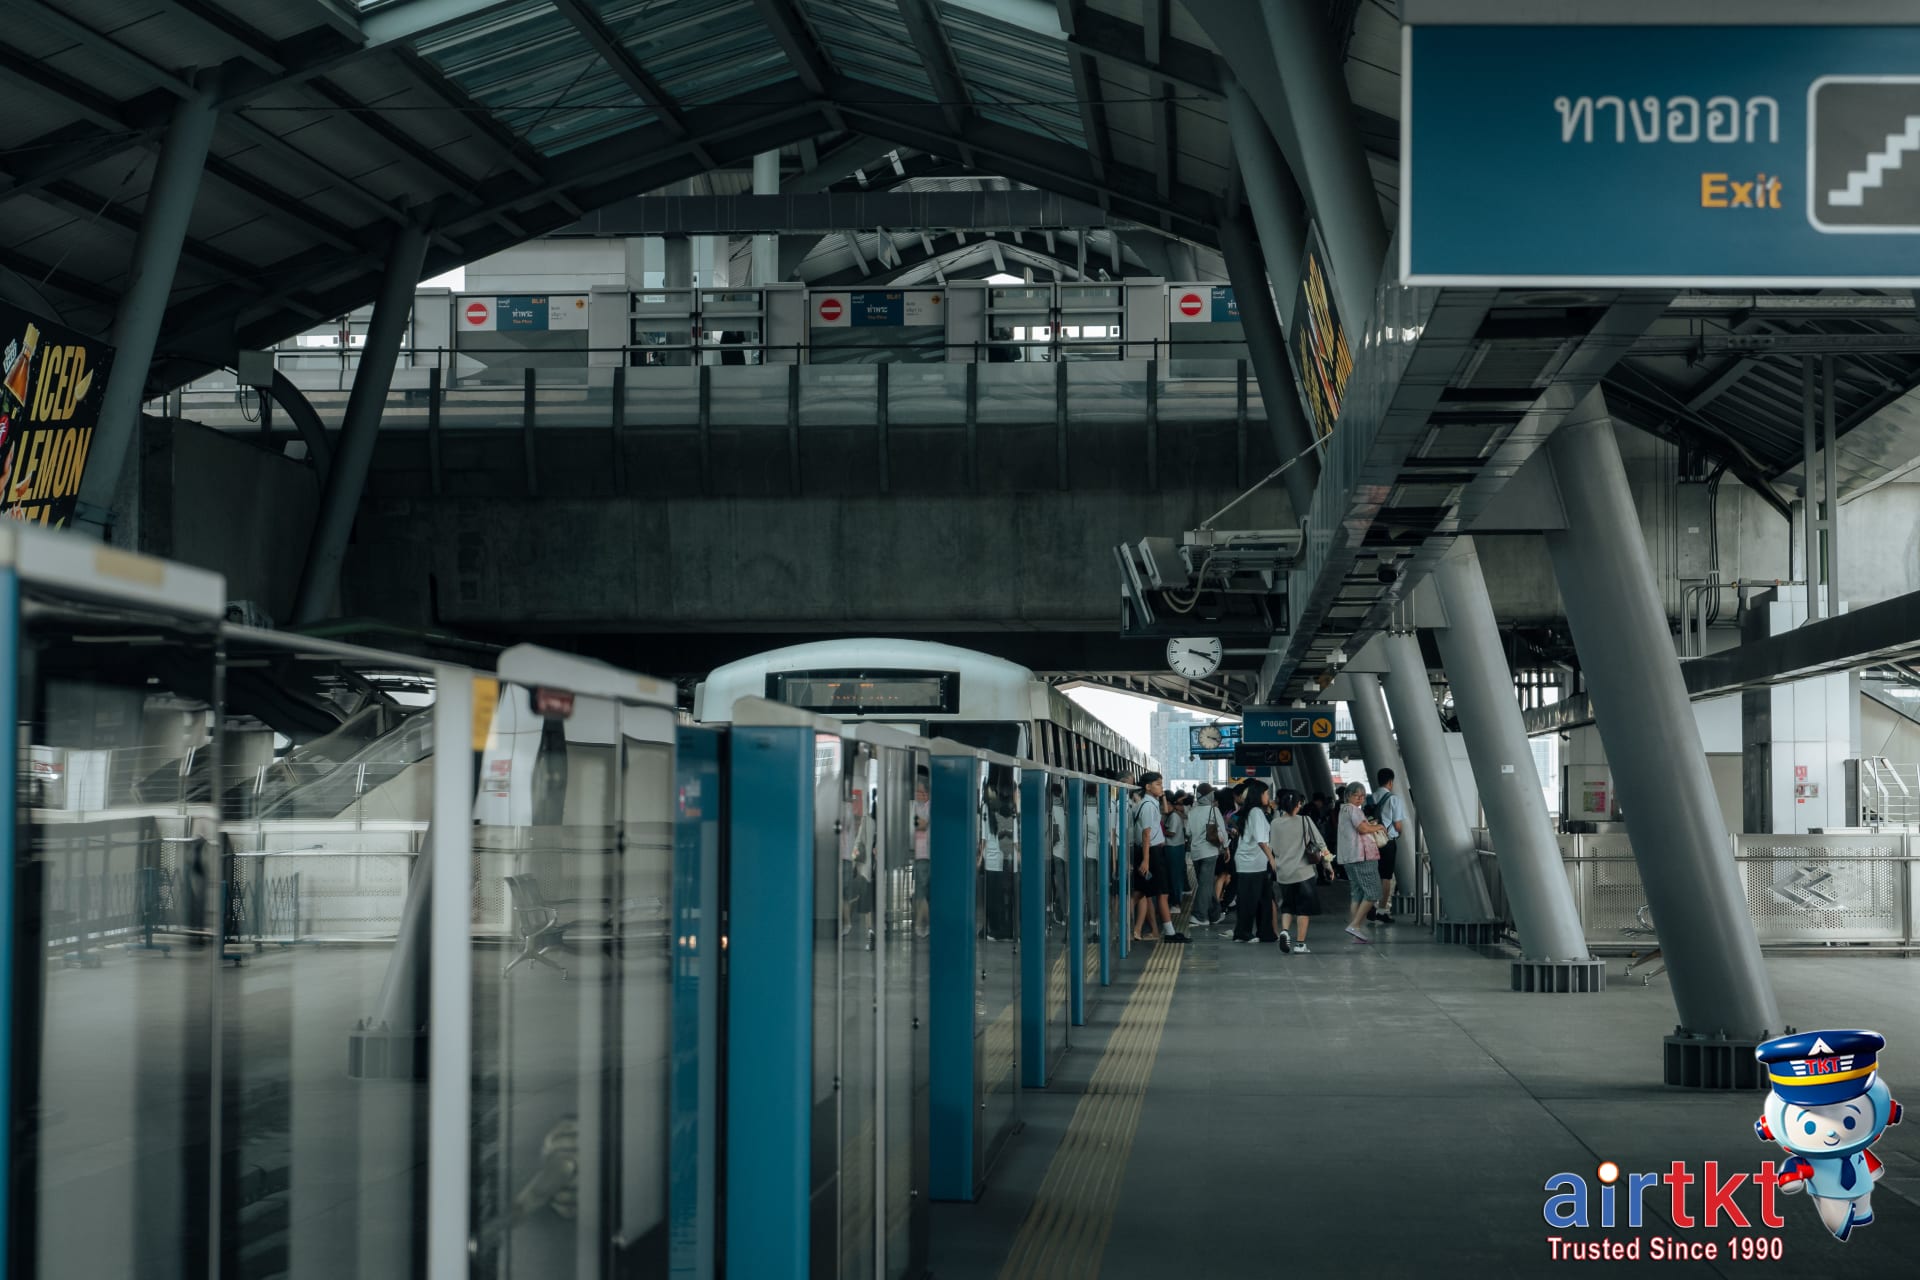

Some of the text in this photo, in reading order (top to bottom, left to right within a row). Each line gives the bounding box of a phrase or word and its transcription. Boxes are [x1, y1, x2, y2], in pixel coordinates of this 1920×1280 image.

[1554, 96, 1779, 143] ทางออก
[1701, 172, 1782, 208] Exit
[30, 345, 86, 421] ICED
[8, 427, 93, 503] LEMON
